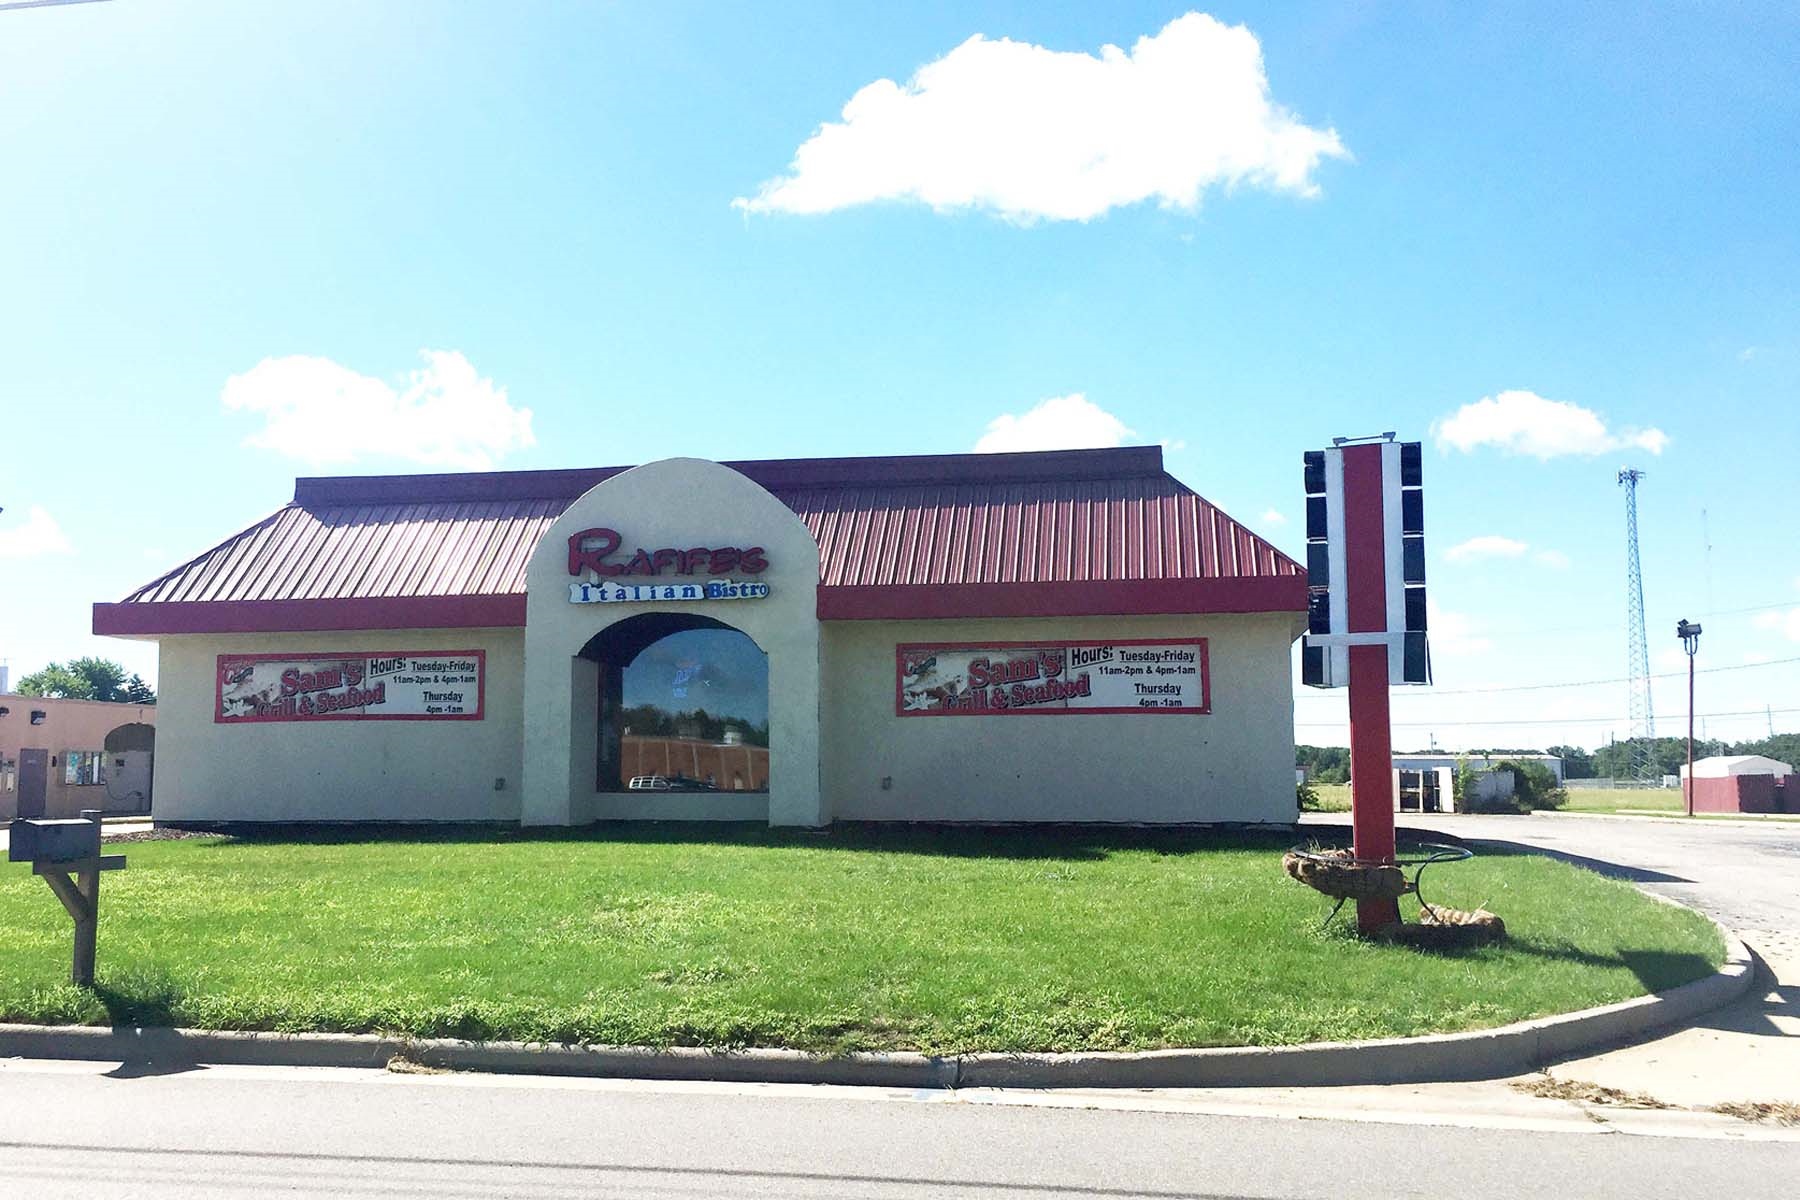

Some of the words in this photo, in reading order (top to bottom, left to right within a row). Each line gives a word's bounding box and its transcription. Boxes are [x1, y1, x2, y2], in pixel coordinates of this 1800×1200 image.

[581, 584, 697, 603] Italian
[707, 582, 768, 600] Bistro
[1071, 646, 1114, 666] Hours:
[1119, 650, 1195, 663] Tuesday-Friday
[370, 657, 407, 675] Hours:
[411, 660, 476, 673] Tuesday-Friday
[968, 652, 1063, 689] Sam's
[1098, 666, 1144, 676] 11am-2pm
[1146, 666, 1153, 675] &
[1156, 666, 1196, 676] 4pm-1am
[281, 661, 363, 697] Sam's
[393, 675, 431, 685] 11am-2pm
[433, 675, 439, 684] &
[441, 675, 476, 685] 4pm-1am
[989, 686, 1009, 708] &
[1011, 671, 1092, 708] Seafood
[1134, 683, 1182, 696] Thursday
[298, 695, 315, 714] &
[316, 681, 386, 714] Seafood
[423, 691, 463, 703] Thursday
[1139, 698, 1158, 707] 4pm
[426, 705, 442, 713] 4pm
